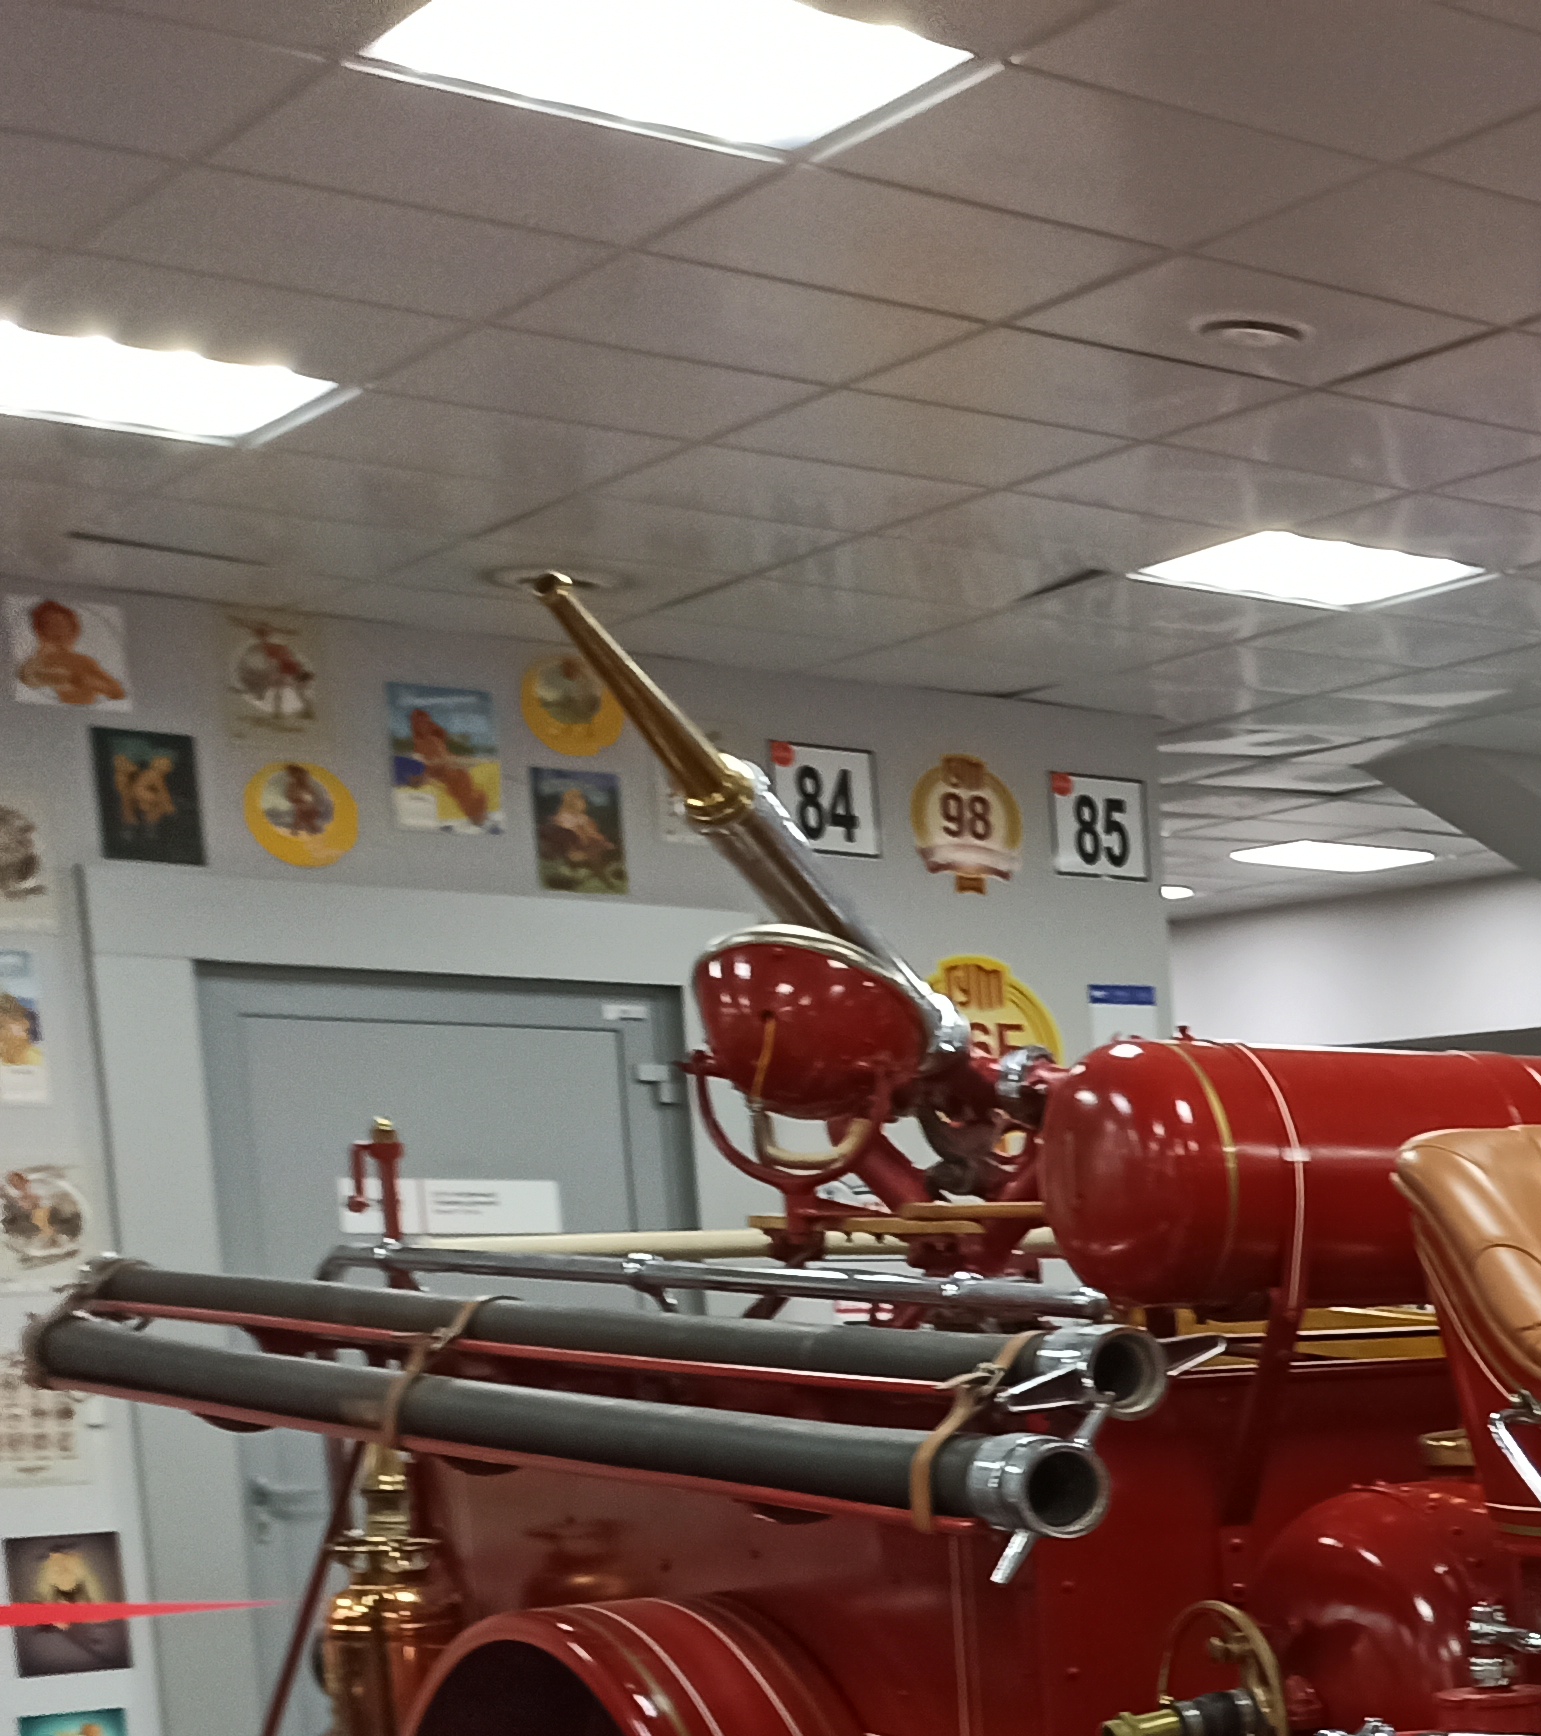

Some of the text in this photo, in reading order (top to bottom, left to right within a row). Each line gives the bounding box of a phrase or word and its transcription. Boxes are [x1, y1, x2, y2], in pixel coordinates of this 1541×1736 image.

[796, 765, 858, 842] 84
[939, 791, 992, 841] 98
[1074, 794, 1129, 868] 85
